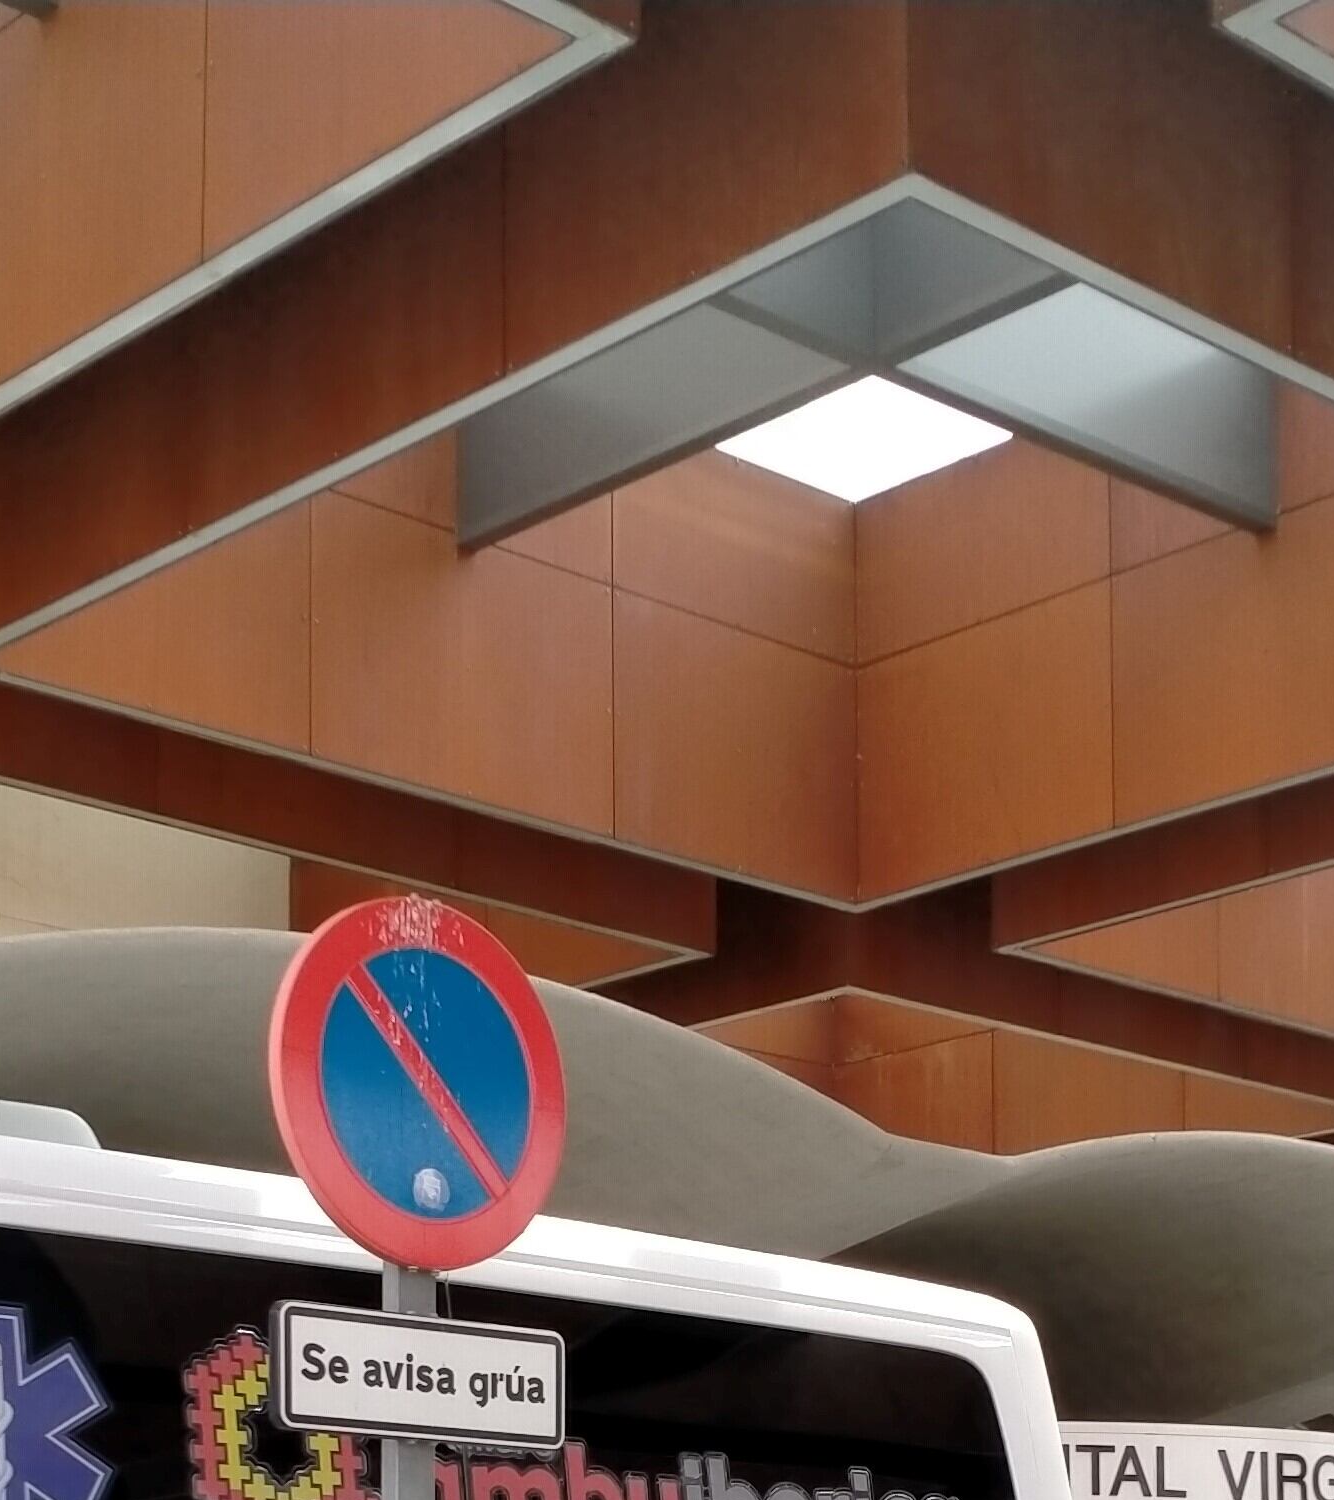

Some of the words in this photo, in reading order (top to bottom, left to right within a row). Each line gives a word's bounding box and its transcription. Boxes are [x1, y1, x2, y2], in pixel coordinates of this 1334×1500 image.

[301, 1342, 350, 1384] Se
[363, 1353, 456, 1396] avisa
[469, 1366, 546, 1408] grúa
